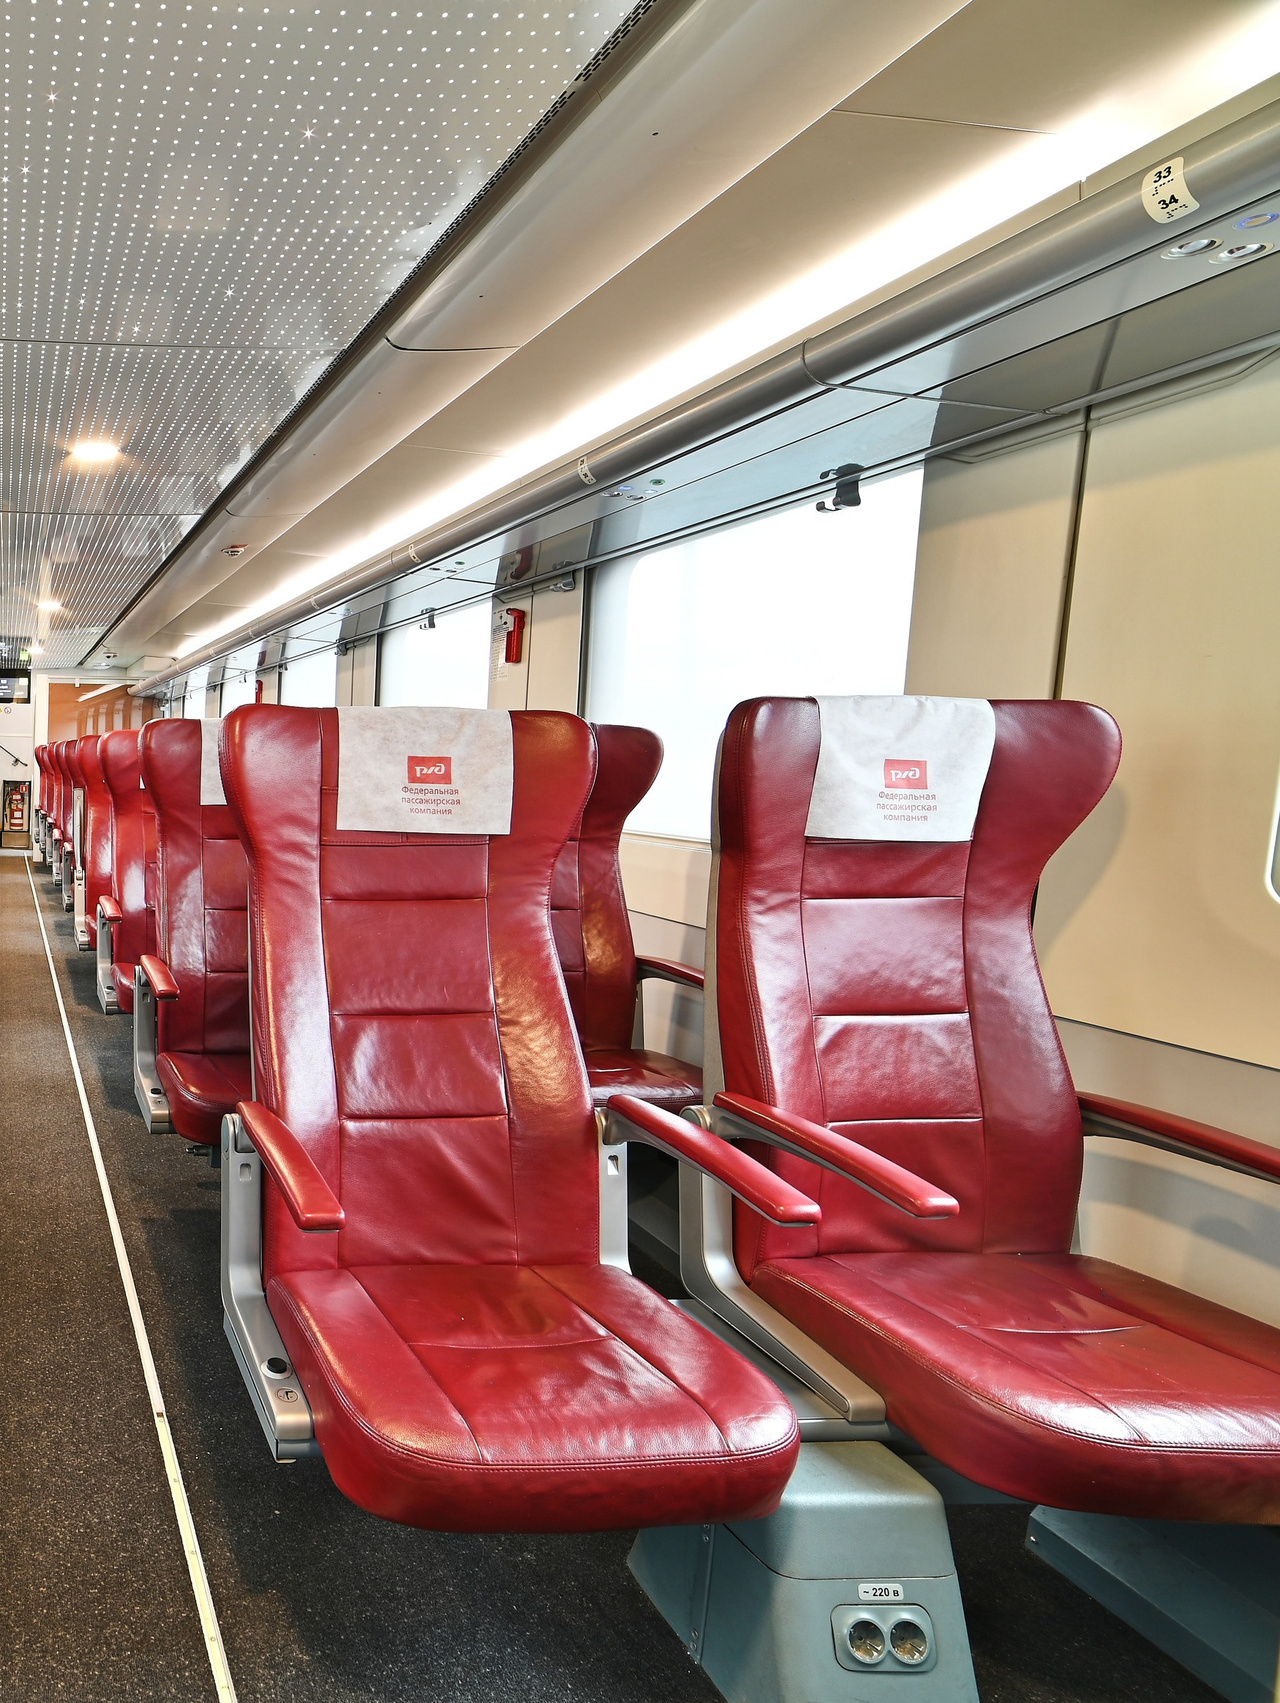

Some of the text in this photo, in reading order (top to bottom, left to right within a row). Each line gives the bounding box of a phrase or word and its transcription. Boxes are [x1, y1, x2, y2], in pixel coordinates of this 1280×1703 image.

[1153, 165, 1172, 183] 33
[1157, 194, 1179, 210] 34
[401, 785, 459, 796] Федеральная
[401, 796, 461, 806] пассажирская
[878, 791, 936, 802] Федеральная
[409, 807, 452, 815] компания
[876, 803, 938, 813] пассажирская
[883, 814, 928, 822] компания
[872, 1587, 890, 1597] 220
